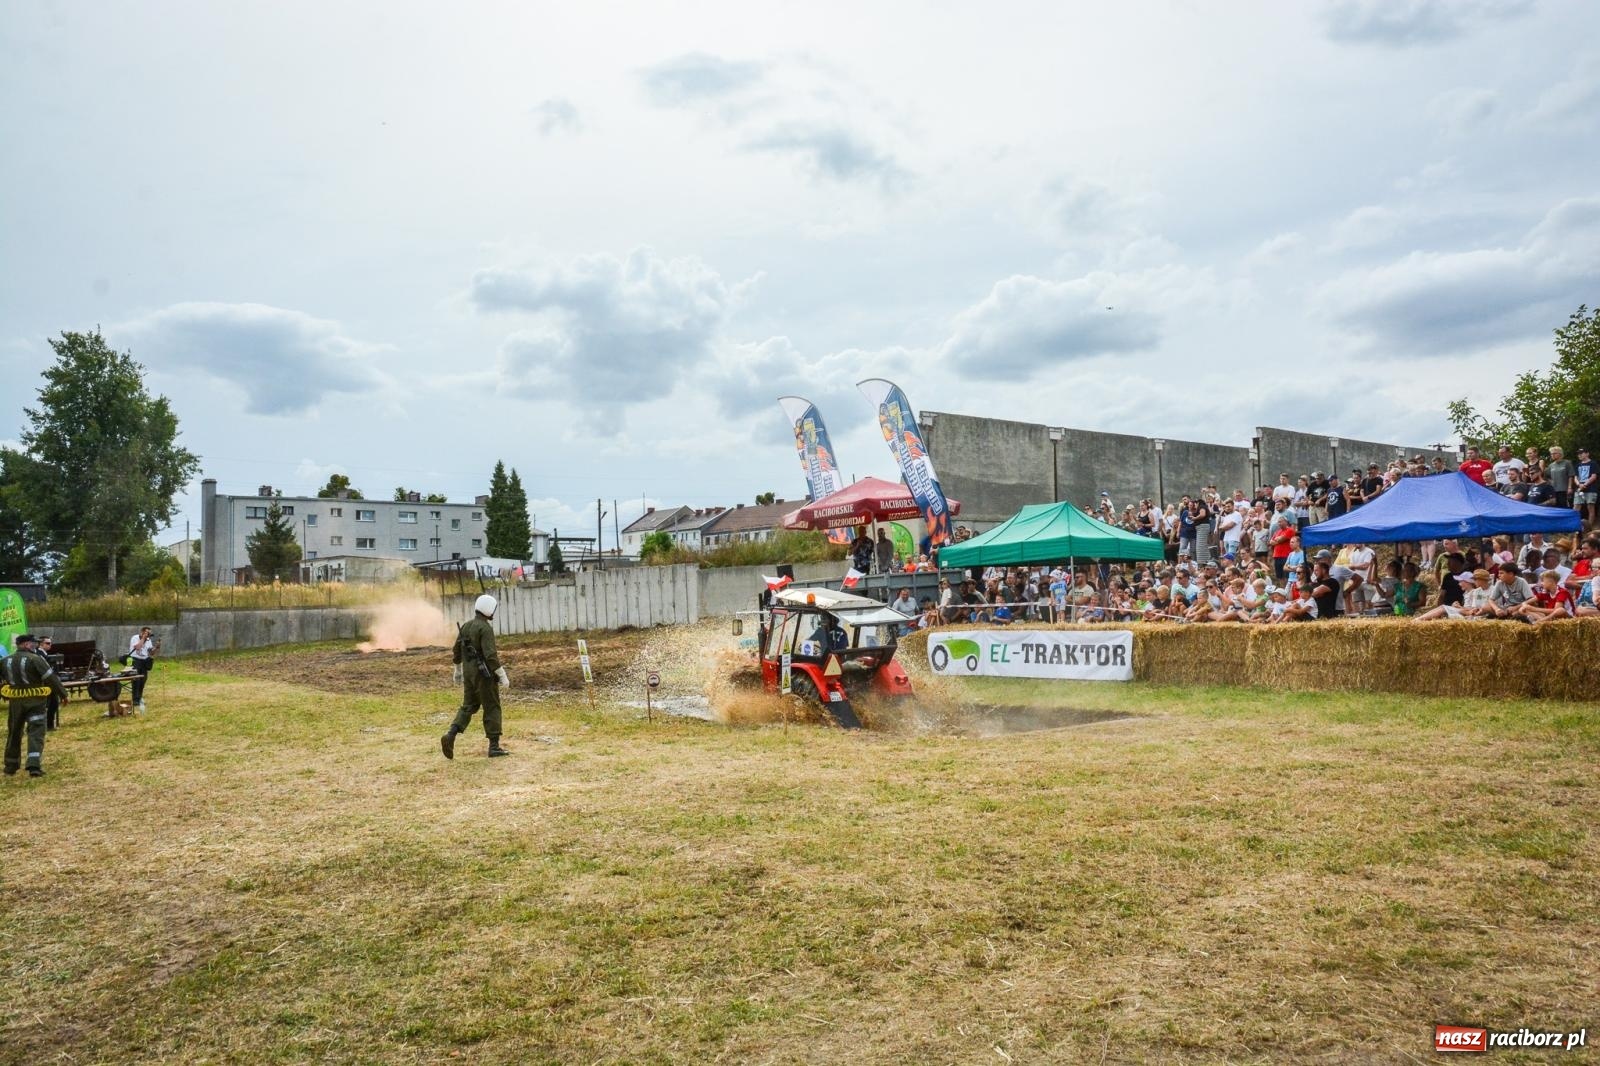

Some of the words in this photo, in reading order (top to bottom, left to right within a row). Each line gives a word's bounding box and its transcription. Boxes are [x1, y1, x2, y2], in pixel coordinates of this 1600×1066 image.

[813, 503, 855, 519] RACIBORSKIE
[880, 498, 920, 510] RACIBORSK
[990, 643, 1126, 666] EL-TRAKTOR
